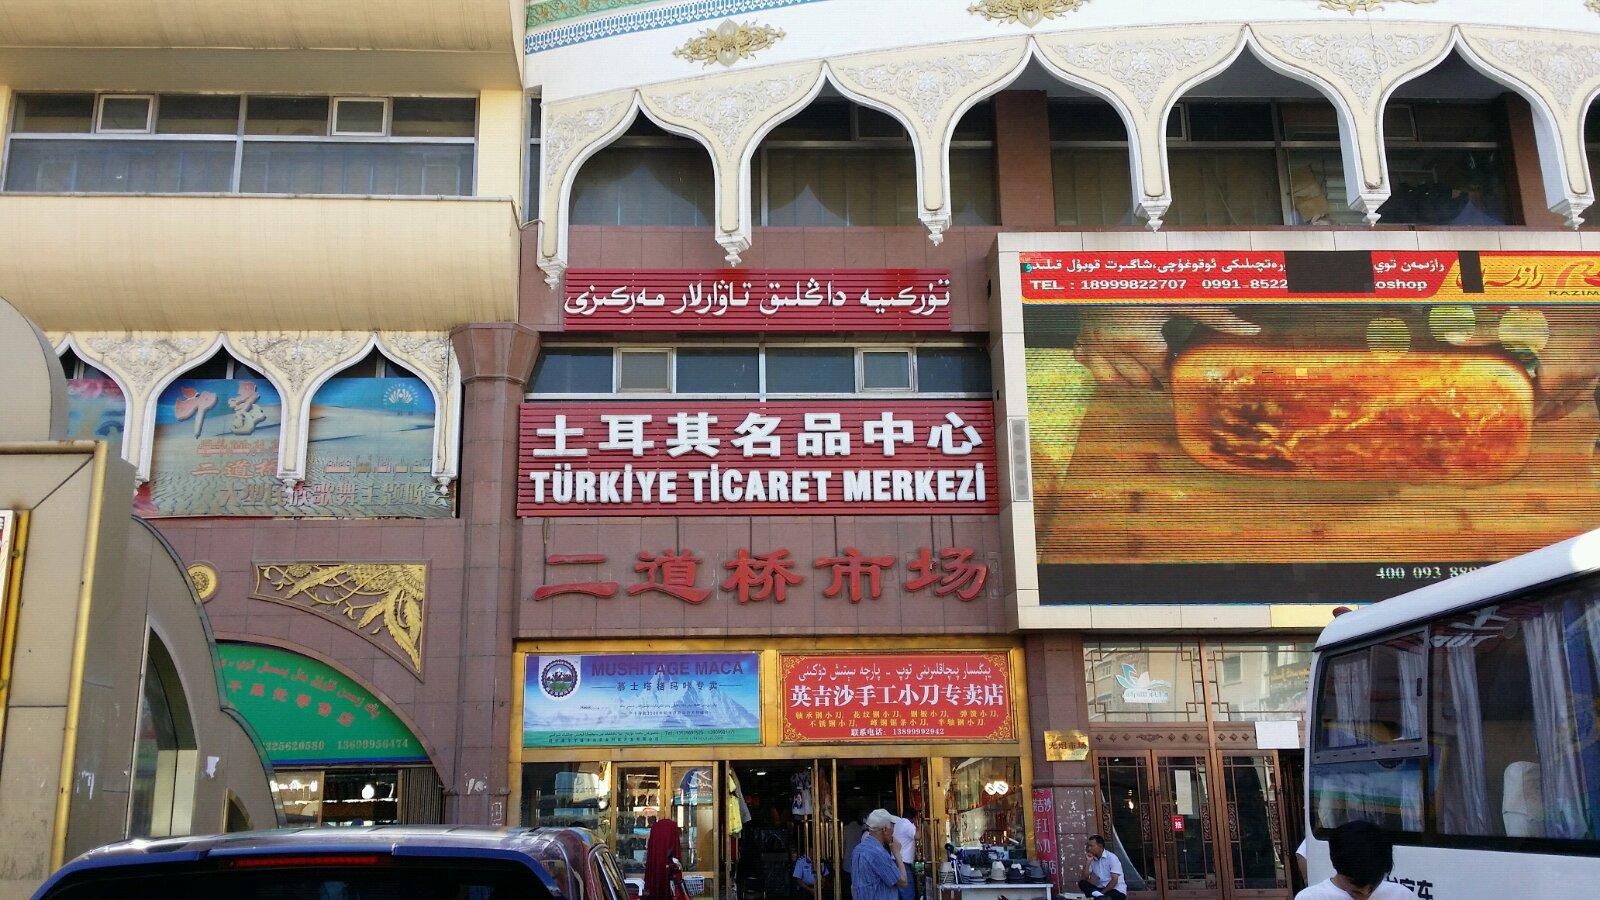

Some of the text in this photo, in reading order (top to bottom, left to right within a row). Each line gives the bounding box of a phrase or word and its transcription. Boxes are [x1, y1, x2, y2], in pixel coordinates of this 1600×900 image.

[1081, 279, 1187, 290] 18999822707
[533, 411, 984, 458] 土耳其名品中心
[529, 462, 987, 504] TÜRKİYE TİCARET MERKEZİ
[534, 547, 989, 605] 二道桥市场
[1376, 567, 1405, 579] 400
[1413, 567, 1442, 579] 093
[591, 660, 744, 677] MUSHITAGE MACA
[790, 684, 1004, 708] 英吉沙手工小刀专卖店
